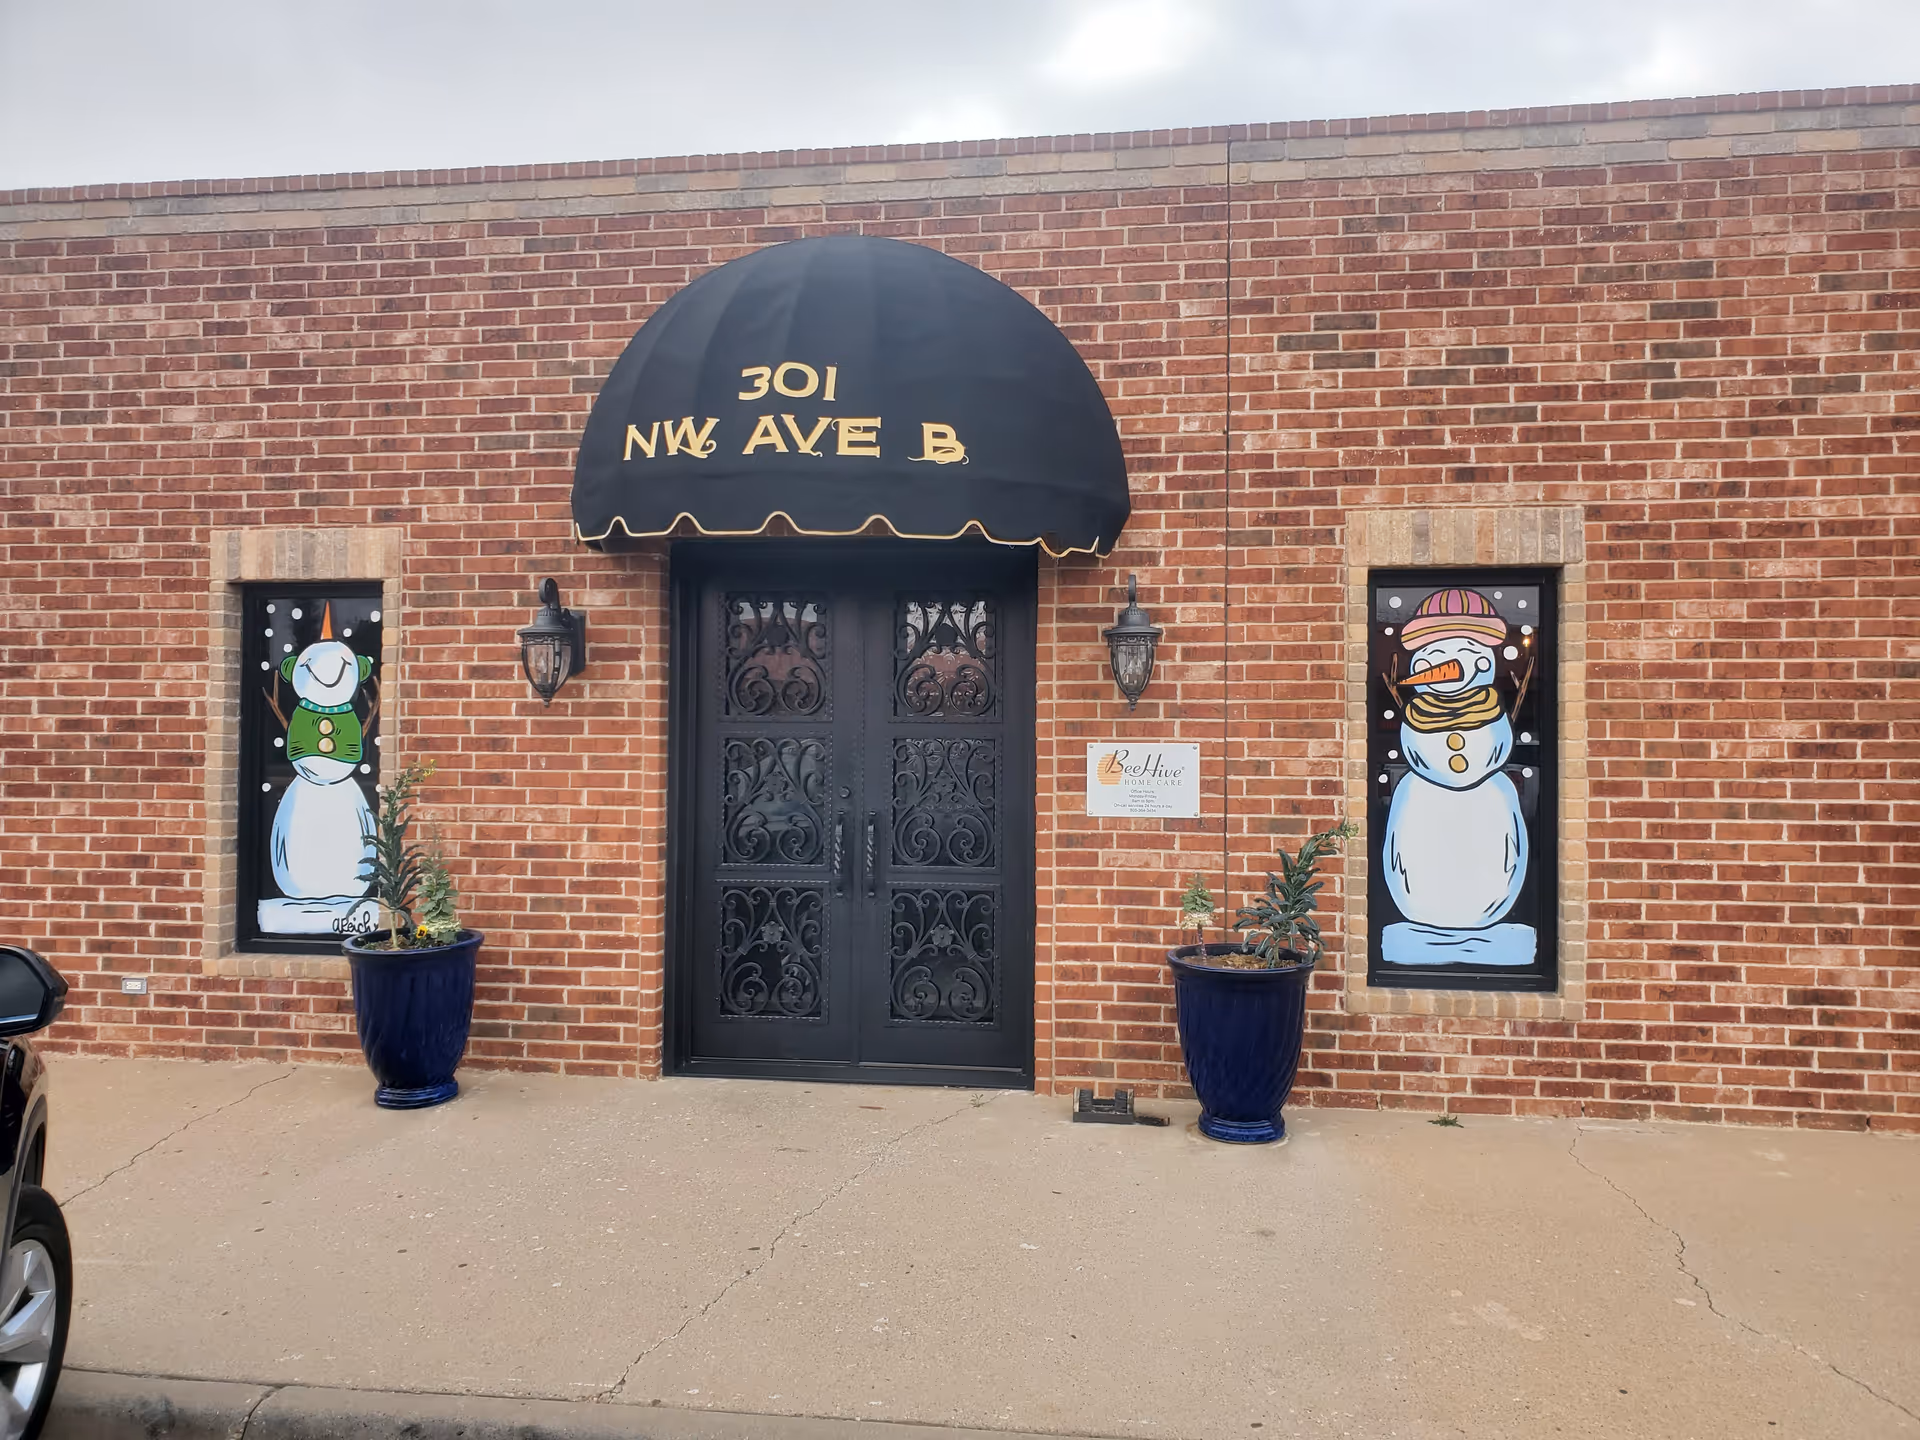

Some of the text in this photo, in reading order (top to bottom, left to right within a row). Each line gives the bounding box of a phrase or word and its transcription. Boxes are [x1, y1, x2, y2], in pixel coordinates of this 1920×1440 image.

[738, 361, 837, 401] 301
[623, 413, 970, 465] NW AVE B
